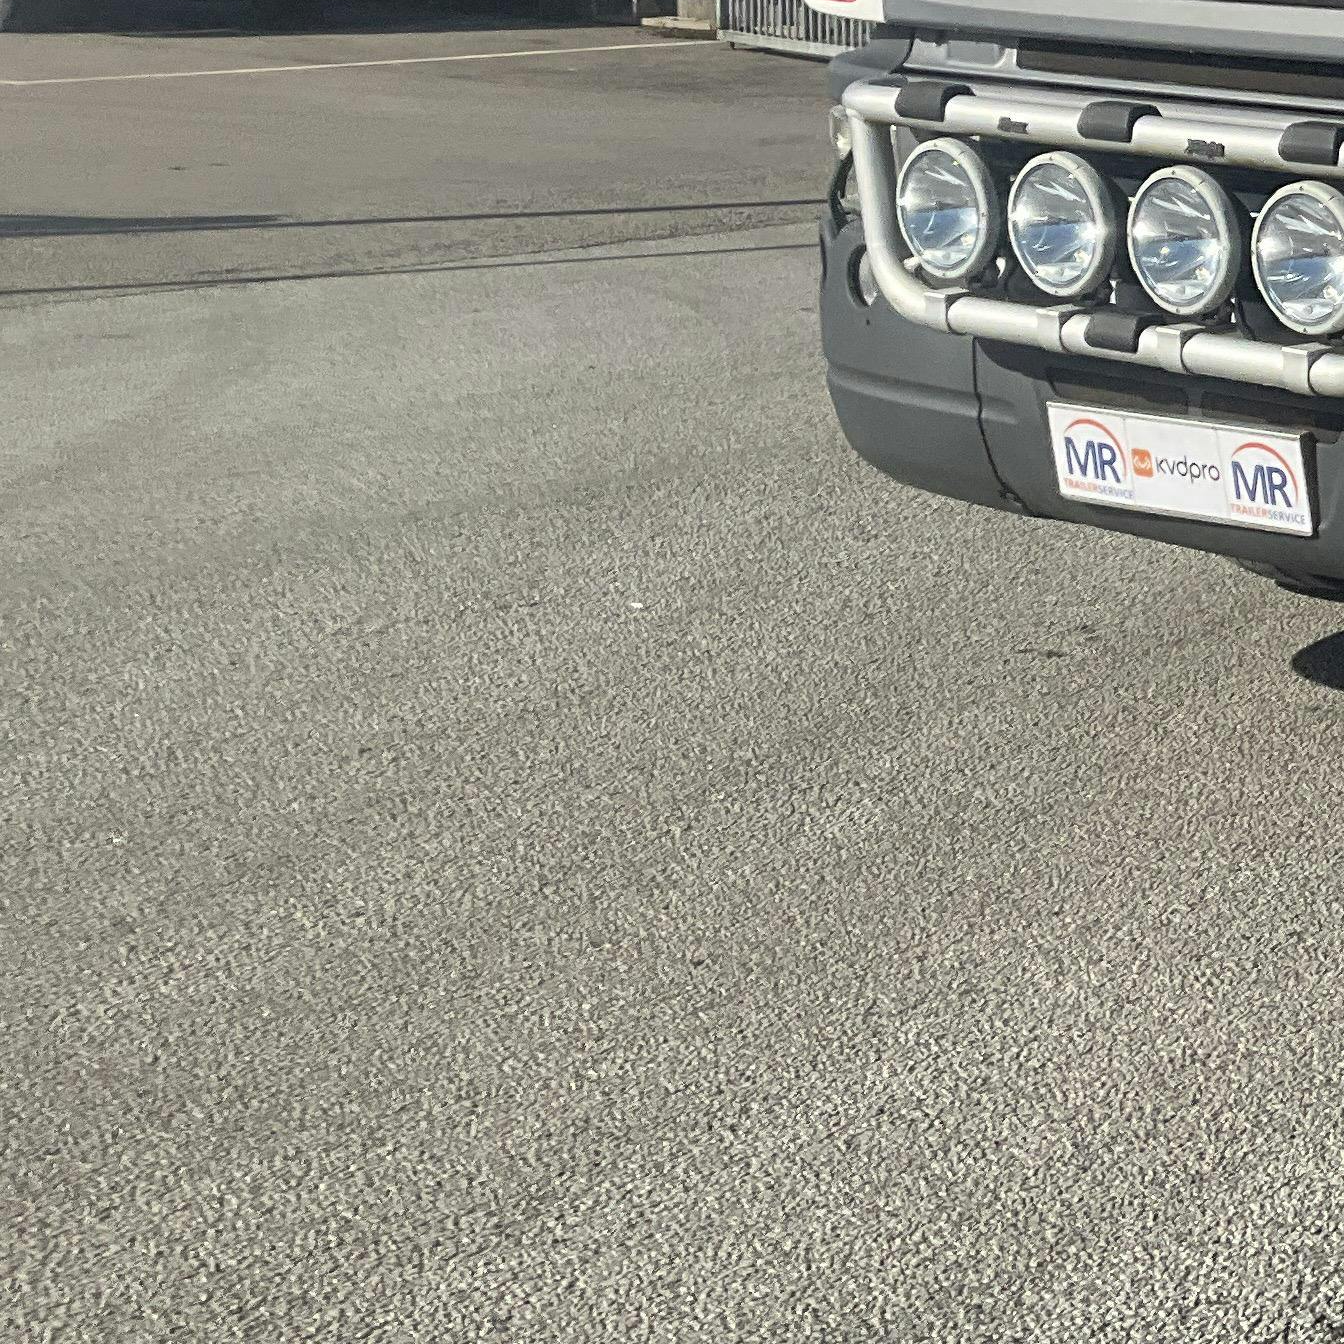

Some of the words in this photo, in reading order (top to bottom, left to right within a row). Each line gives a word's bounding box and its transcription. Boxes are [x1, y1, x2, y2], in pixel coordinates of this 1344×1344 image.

[1064, 436, 1121, 484] MR
[1155, 455, 1220, 484] kvdpro
[1231, 460, 1293, 508] MR
